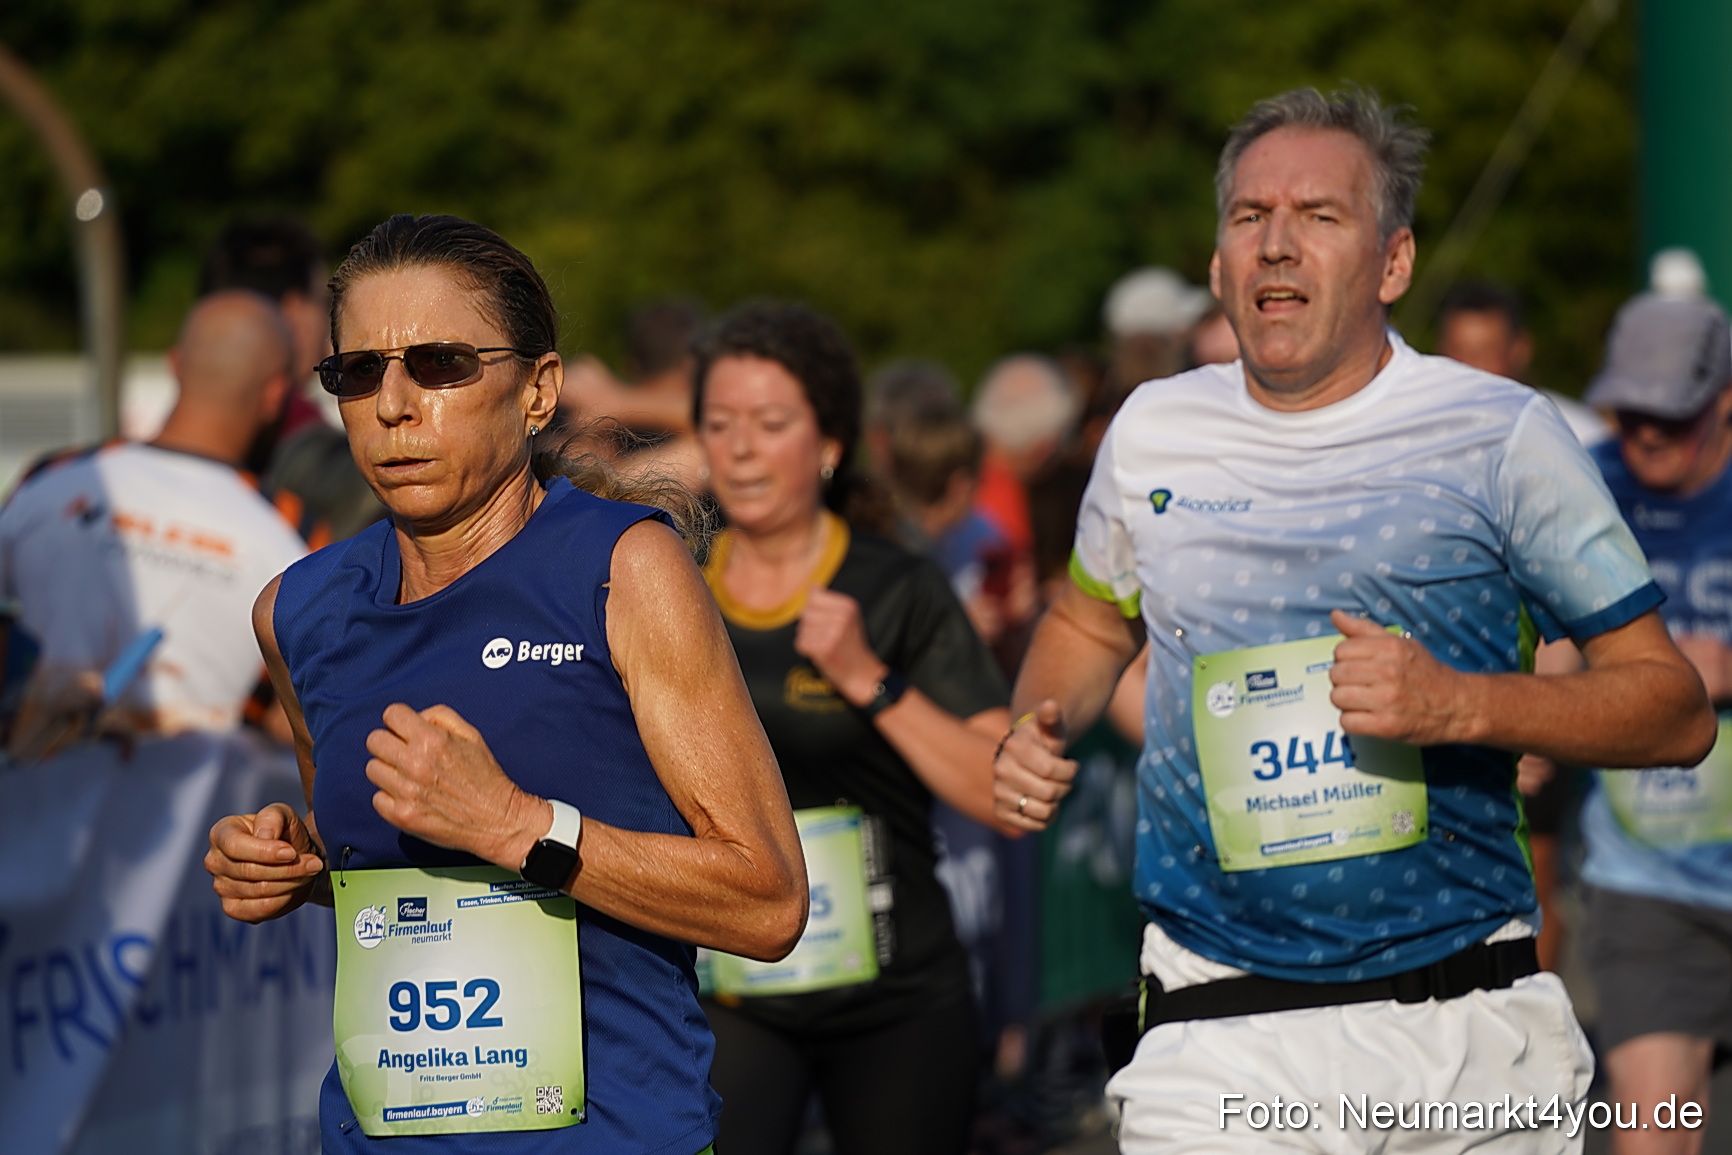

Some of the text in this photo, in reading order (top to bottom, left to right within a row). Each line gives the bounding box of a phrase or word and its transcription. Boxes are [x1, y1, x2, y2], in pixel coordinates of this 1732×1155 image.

[517, 640, 584, 666] Berger
[1250, 730, 1356, 781] 344
[1246, 789, 1318, 814] Michael
[1322, 782, 1383, 803] Müller
[460, 899, 480, 907] Essen,
[480, 896, 502, 905] Trinken,
[524, 889, 558, 899] Netzwerken
[388, 918, 453, 937] Firmenlauf
[411, 932, 452, 944] neumarkt
[388, 978, 503, 1031] 952
[377, 1046, 528, 1073] Angelika Lang
[420, 1073, 482, 1083] Fritz Berger GmbH
[386, 1104, 463, 1120] firmenlauf.bayern
